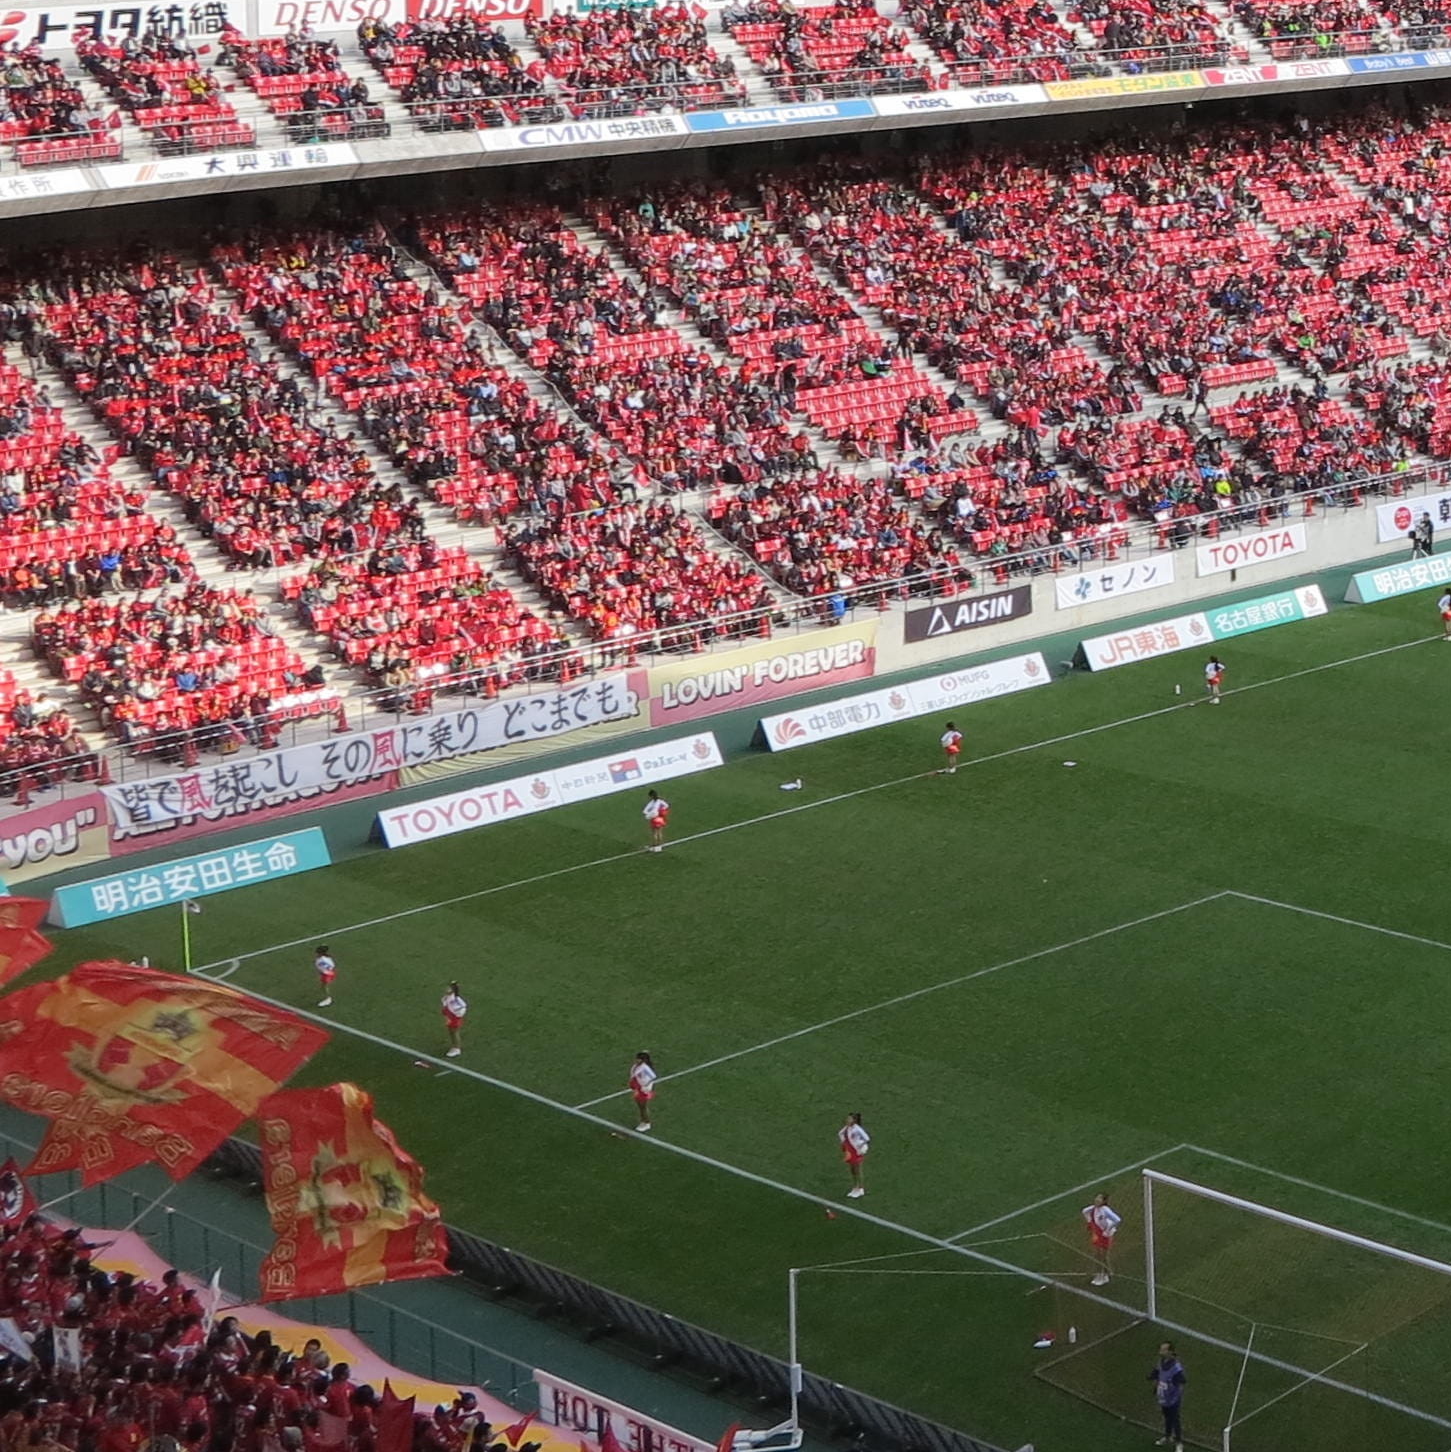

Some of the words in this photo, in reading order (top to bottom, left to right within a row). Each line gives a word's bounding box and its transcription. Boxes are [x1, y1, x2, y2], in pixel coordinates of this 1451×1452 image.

[39, 1, 229, 44] トヨタ紡織
[1221, 67, 1263, 84] ZENT
[1290, 62, 1331, 77] ZENT
[518, 123, 604, 145] CMW
[608, 118, 678, 137] 中央精機
[203, 149, 329, 175] 大興運輸
[1208, 531, 1295, 567] TOYOTA
[1099, 564, 1158, 594] セノン
[954, 593, 1013, 626] AISIN
[1098, 627, 1181, 666] JR東海
[1213, 596, 1296, 634] 名古屋銀行
[661, 665, 748, 710] LOVIN'
[752, 639, 867, 689] FOREVER
[808, 700, 881, 733] 中部電力
[957, 669, 991, 686] MUFG
[119, 757, 298, 824] 皆で風を起こし
[320, 709, 479, 779] その風に乗り
[503, 682, 621, 738] どこまでも
[389, 787, 525, 838] TOYOTA
[561, 770, 610, 791] 中日新聞
[91, 841, 298, 916] 明治安田生命
